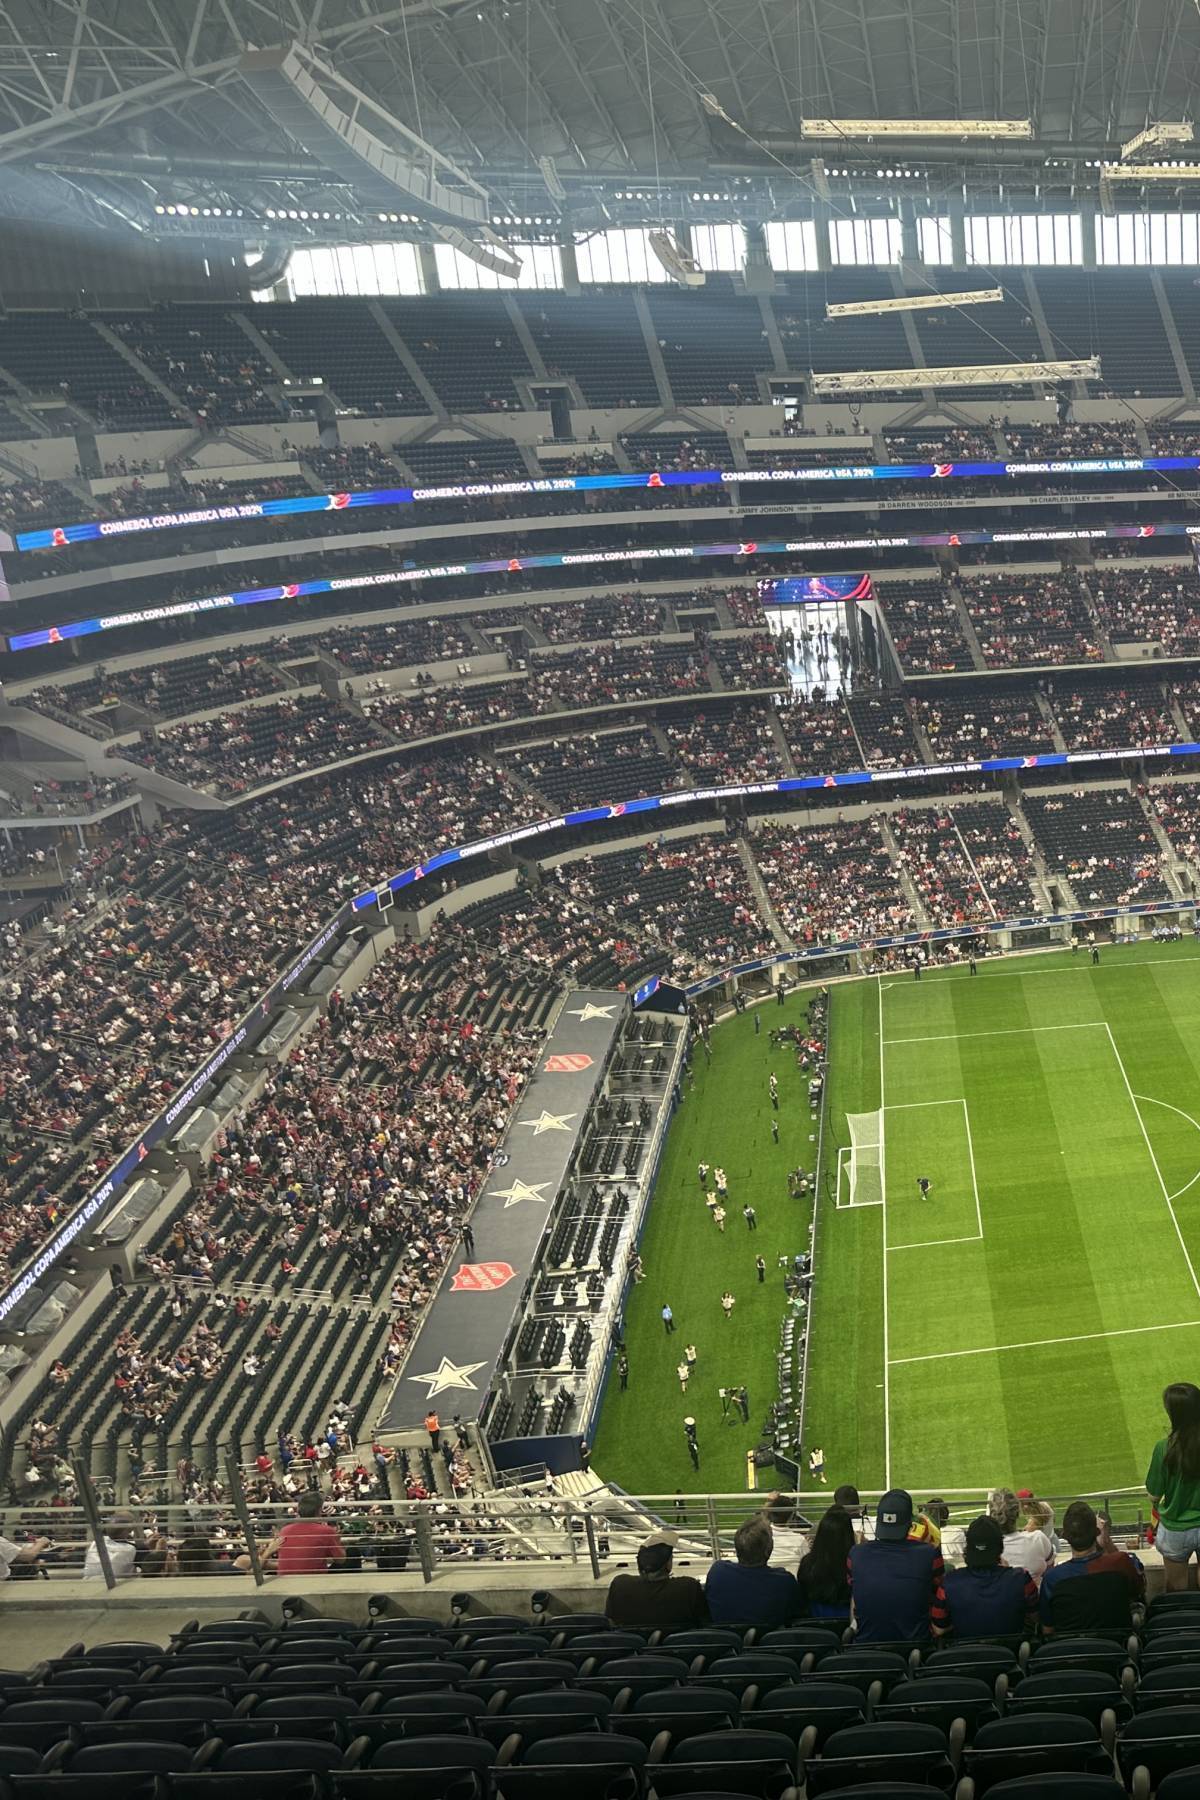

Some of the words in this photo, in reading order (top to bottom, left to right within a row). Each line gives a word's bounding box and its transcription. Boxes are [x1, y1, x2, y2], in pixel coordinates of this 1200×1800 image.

[721, 471, 771, 481] CONMEBOL
[771, 471, 796, 480] COPA
[796, 470, 833, 479] AMERICA
[834, 469, 853, 478] USA
[853, 469, 874, 478] 2024
[1005, 463, 1050, 472] CONMEBOL
[1050, 463, 1073, 472] COPA
[1073, 462, 1107, 471] AMERICA
[1109, 461, 1125, 470] USA
[1125, 460, 1143, 470] 2024
[412, 487, 466, 500] CONMEBOL
[466, 485, 491, 496] COPA
[491, 482, 533, 493] AMERICA
[533, 481, 553, 491] USA
[553, 479, 577, 490] 2024
[100, 518, 153, 535] CONMEBOL
[152, 514, 179, 528] COPA
[178, 509, 219, 524] AMERICA
[218, 507, 238, 518] USA
[239, 504, 263, 517] 2024
[0, 1271, 36, 1321] ONMEBOL
[34, 1248, 57, 1276] COPA
[53, 1213, 86, 1254] AMERICA
[83, 1198, 100, 1219] USA
[97, 1180, 114, 1205] 2024
